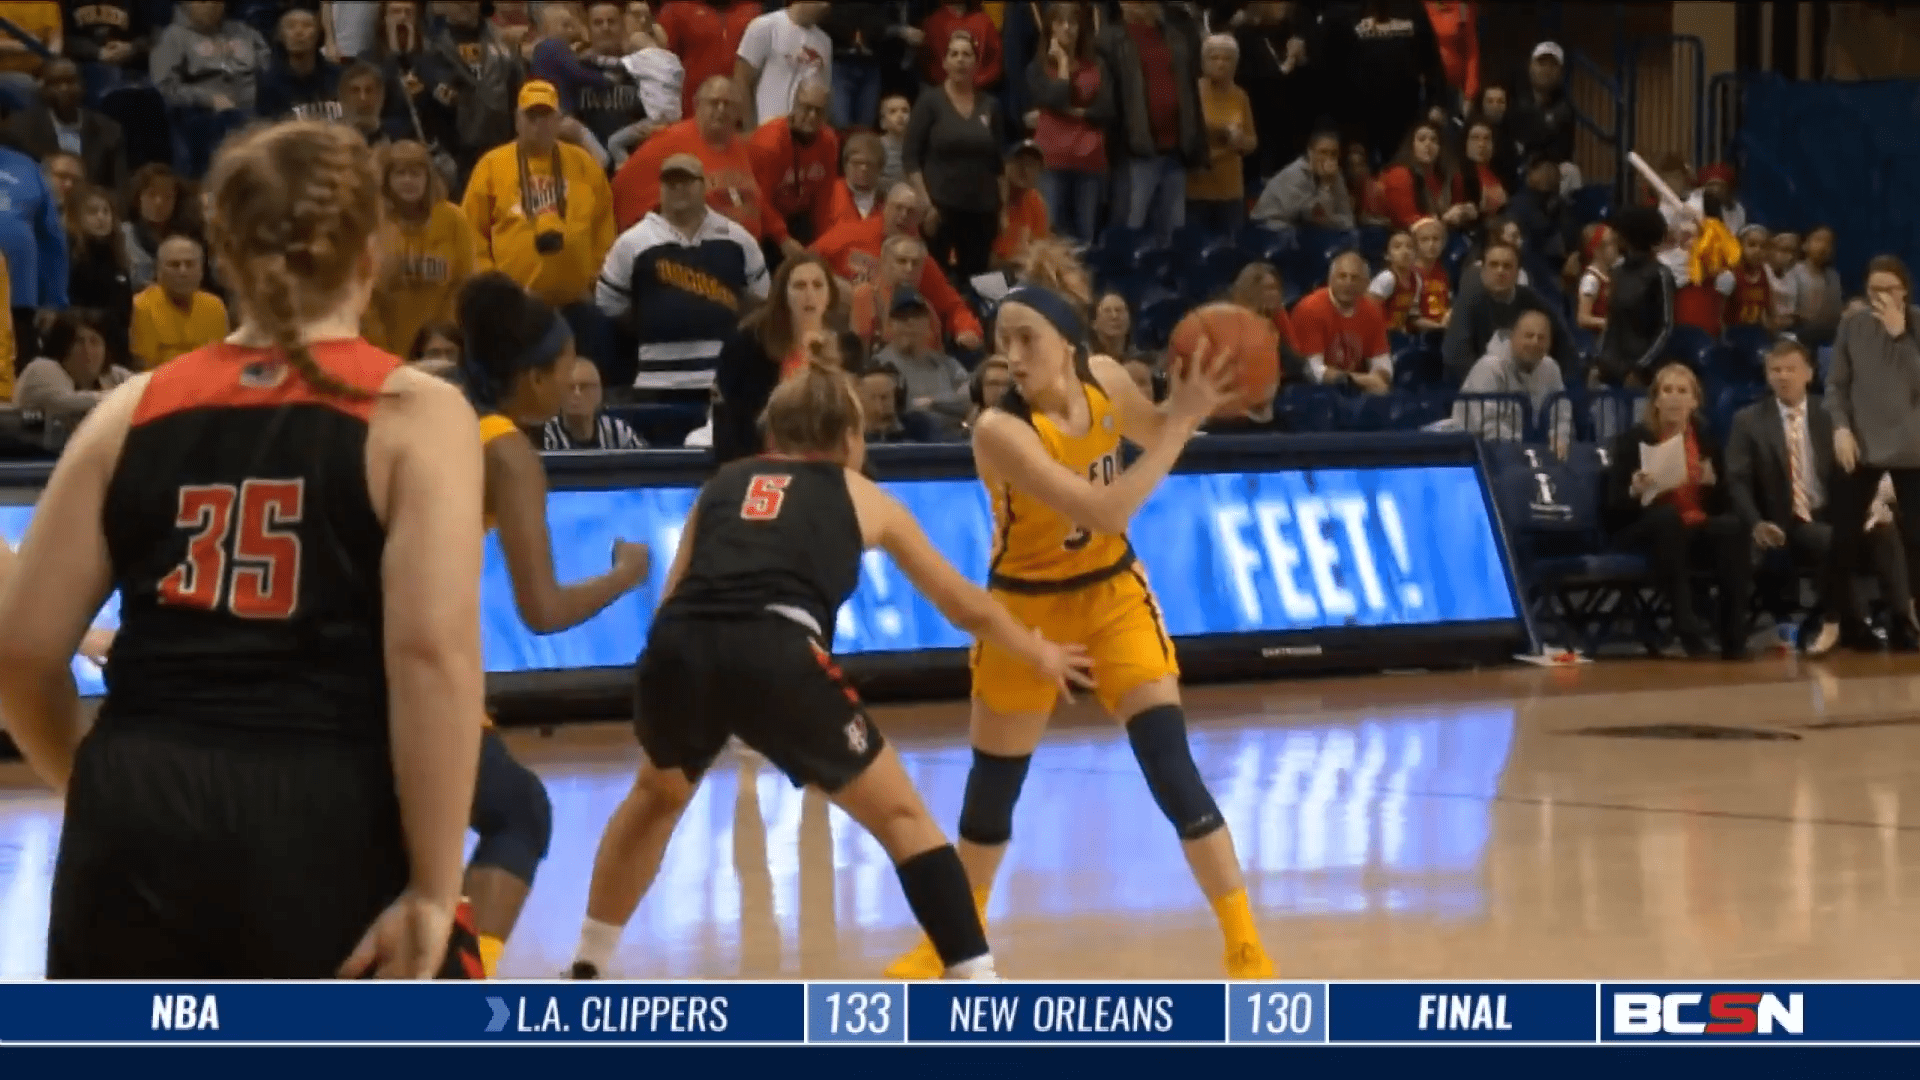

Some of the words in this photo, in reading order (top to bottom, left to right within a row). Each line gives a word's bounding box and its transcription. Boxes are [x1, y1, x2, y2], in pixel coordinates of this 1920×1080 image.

[157, 477, 304, 619] 35
[740, 473, 792, 520] 5
[1212, 491, 1424, 624] FEET!
